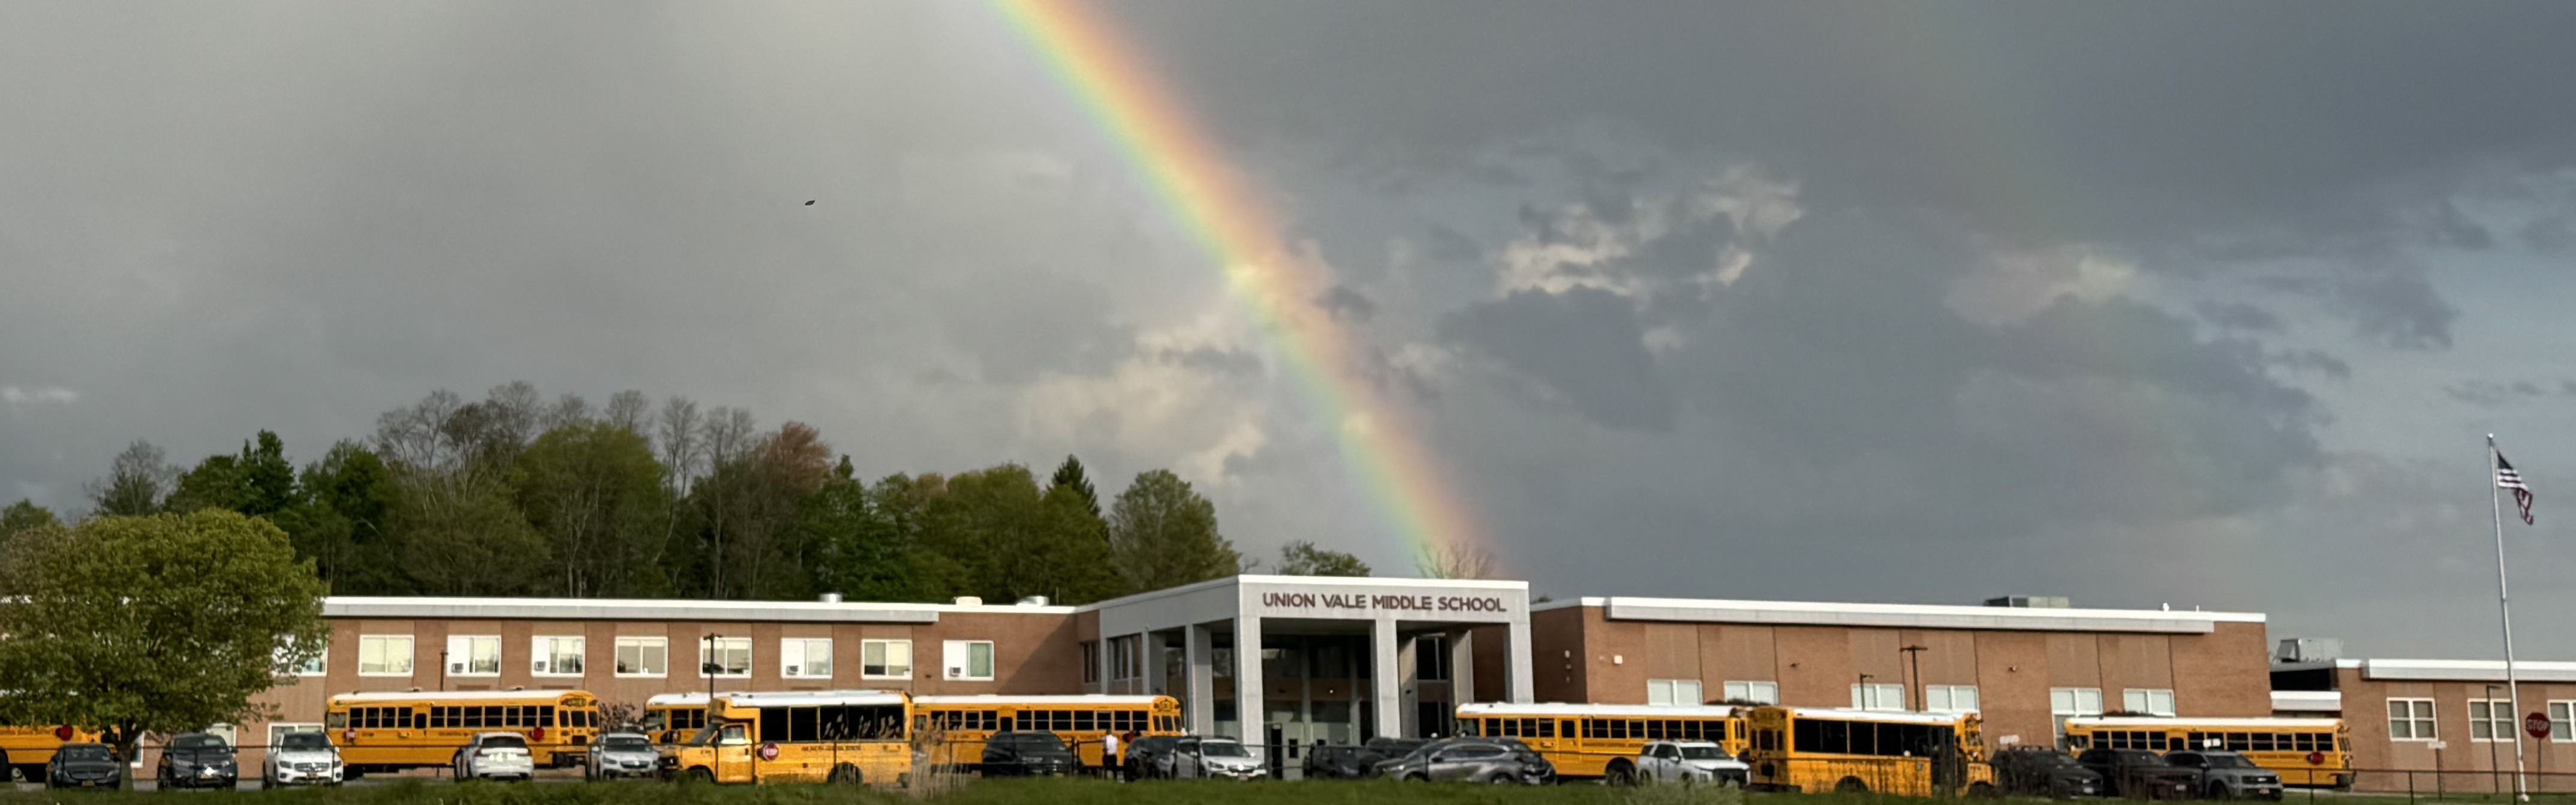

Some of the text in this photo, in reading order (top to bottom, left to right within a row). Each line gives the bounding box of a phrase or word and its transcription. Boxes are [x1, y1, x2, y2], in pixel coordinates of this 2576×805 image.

[1262, 593, 1507, 612] UNION VALE MIDDLE SCHOOL
